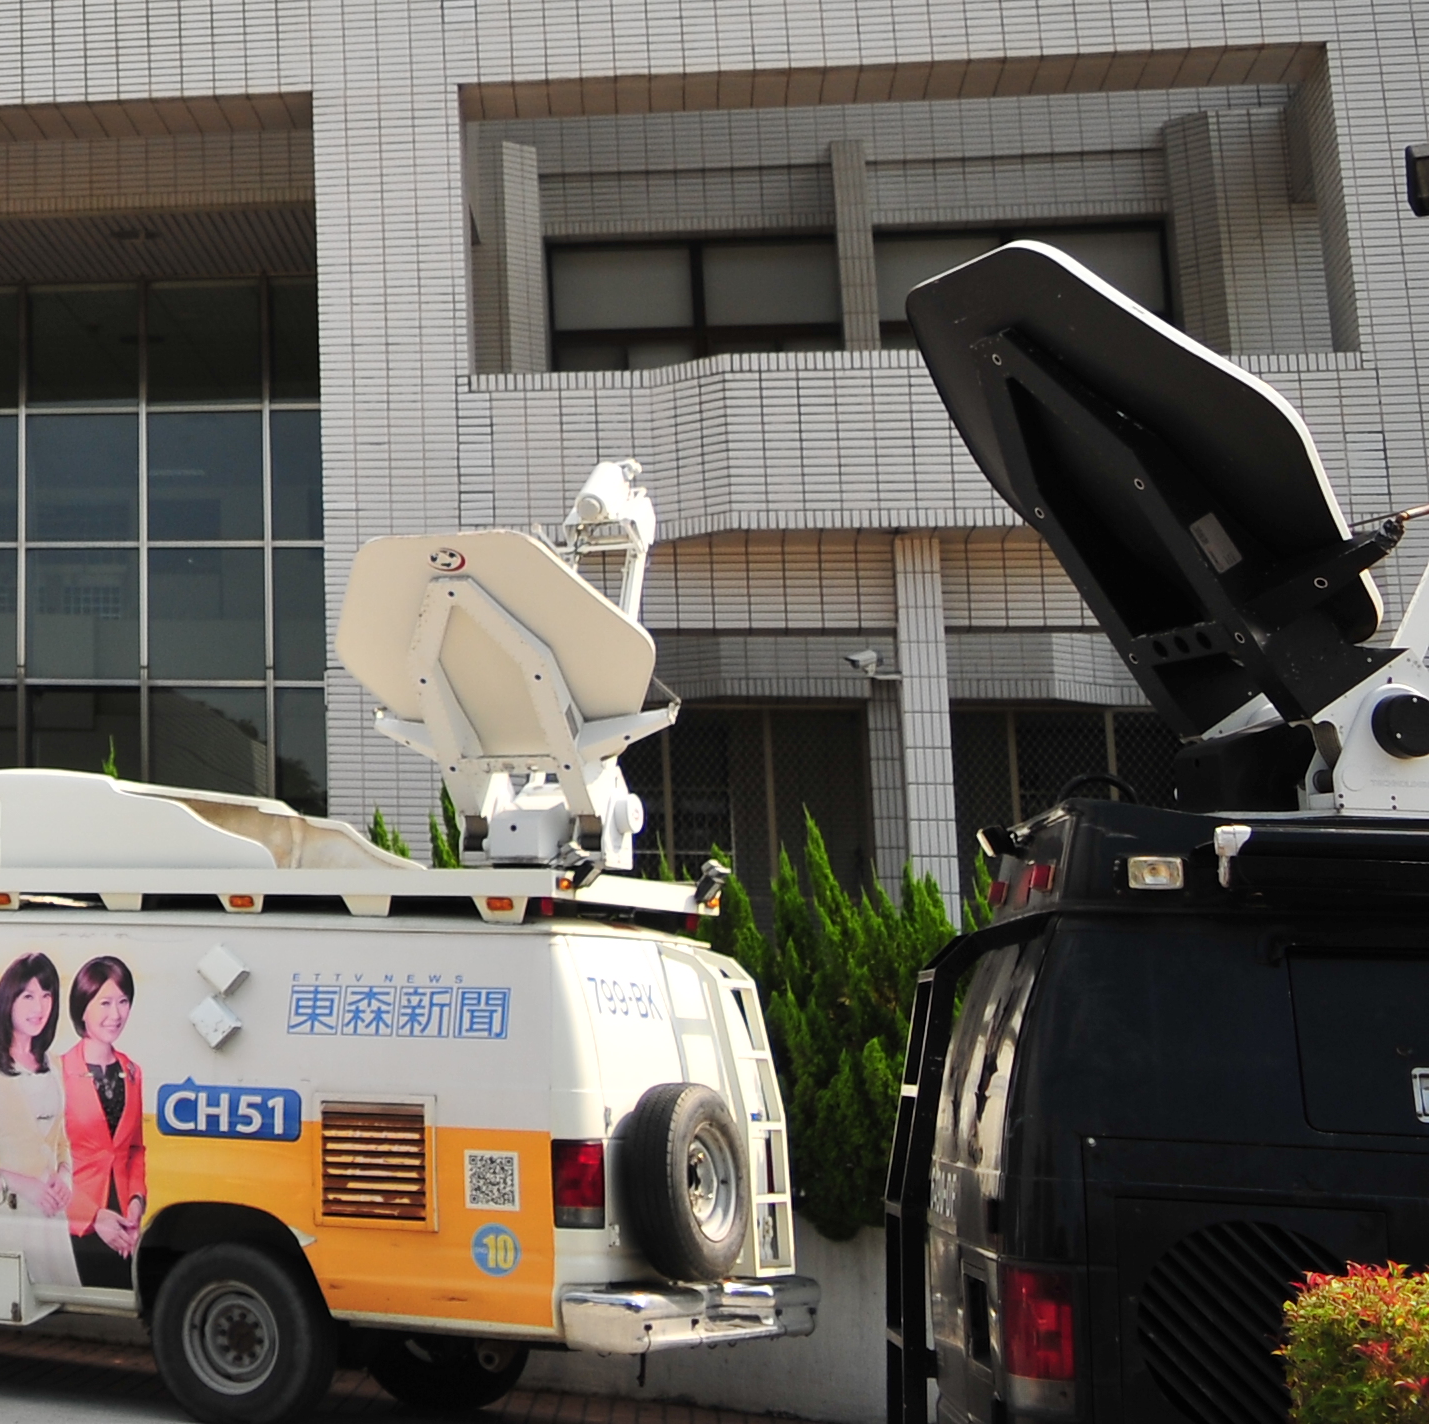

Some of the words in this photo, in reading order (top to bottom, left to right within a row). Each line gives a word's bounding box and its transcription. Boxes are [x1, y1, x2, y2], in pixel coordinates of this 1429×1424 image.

[292, 973, 365, 984] ETTV
[383, 974, 464, 984] NEWS
[586, 976, 664, 1021] 799-BK
[287, 984, 512, 1040] 東森新聞
[482, 1233, 515, 1271] 10
